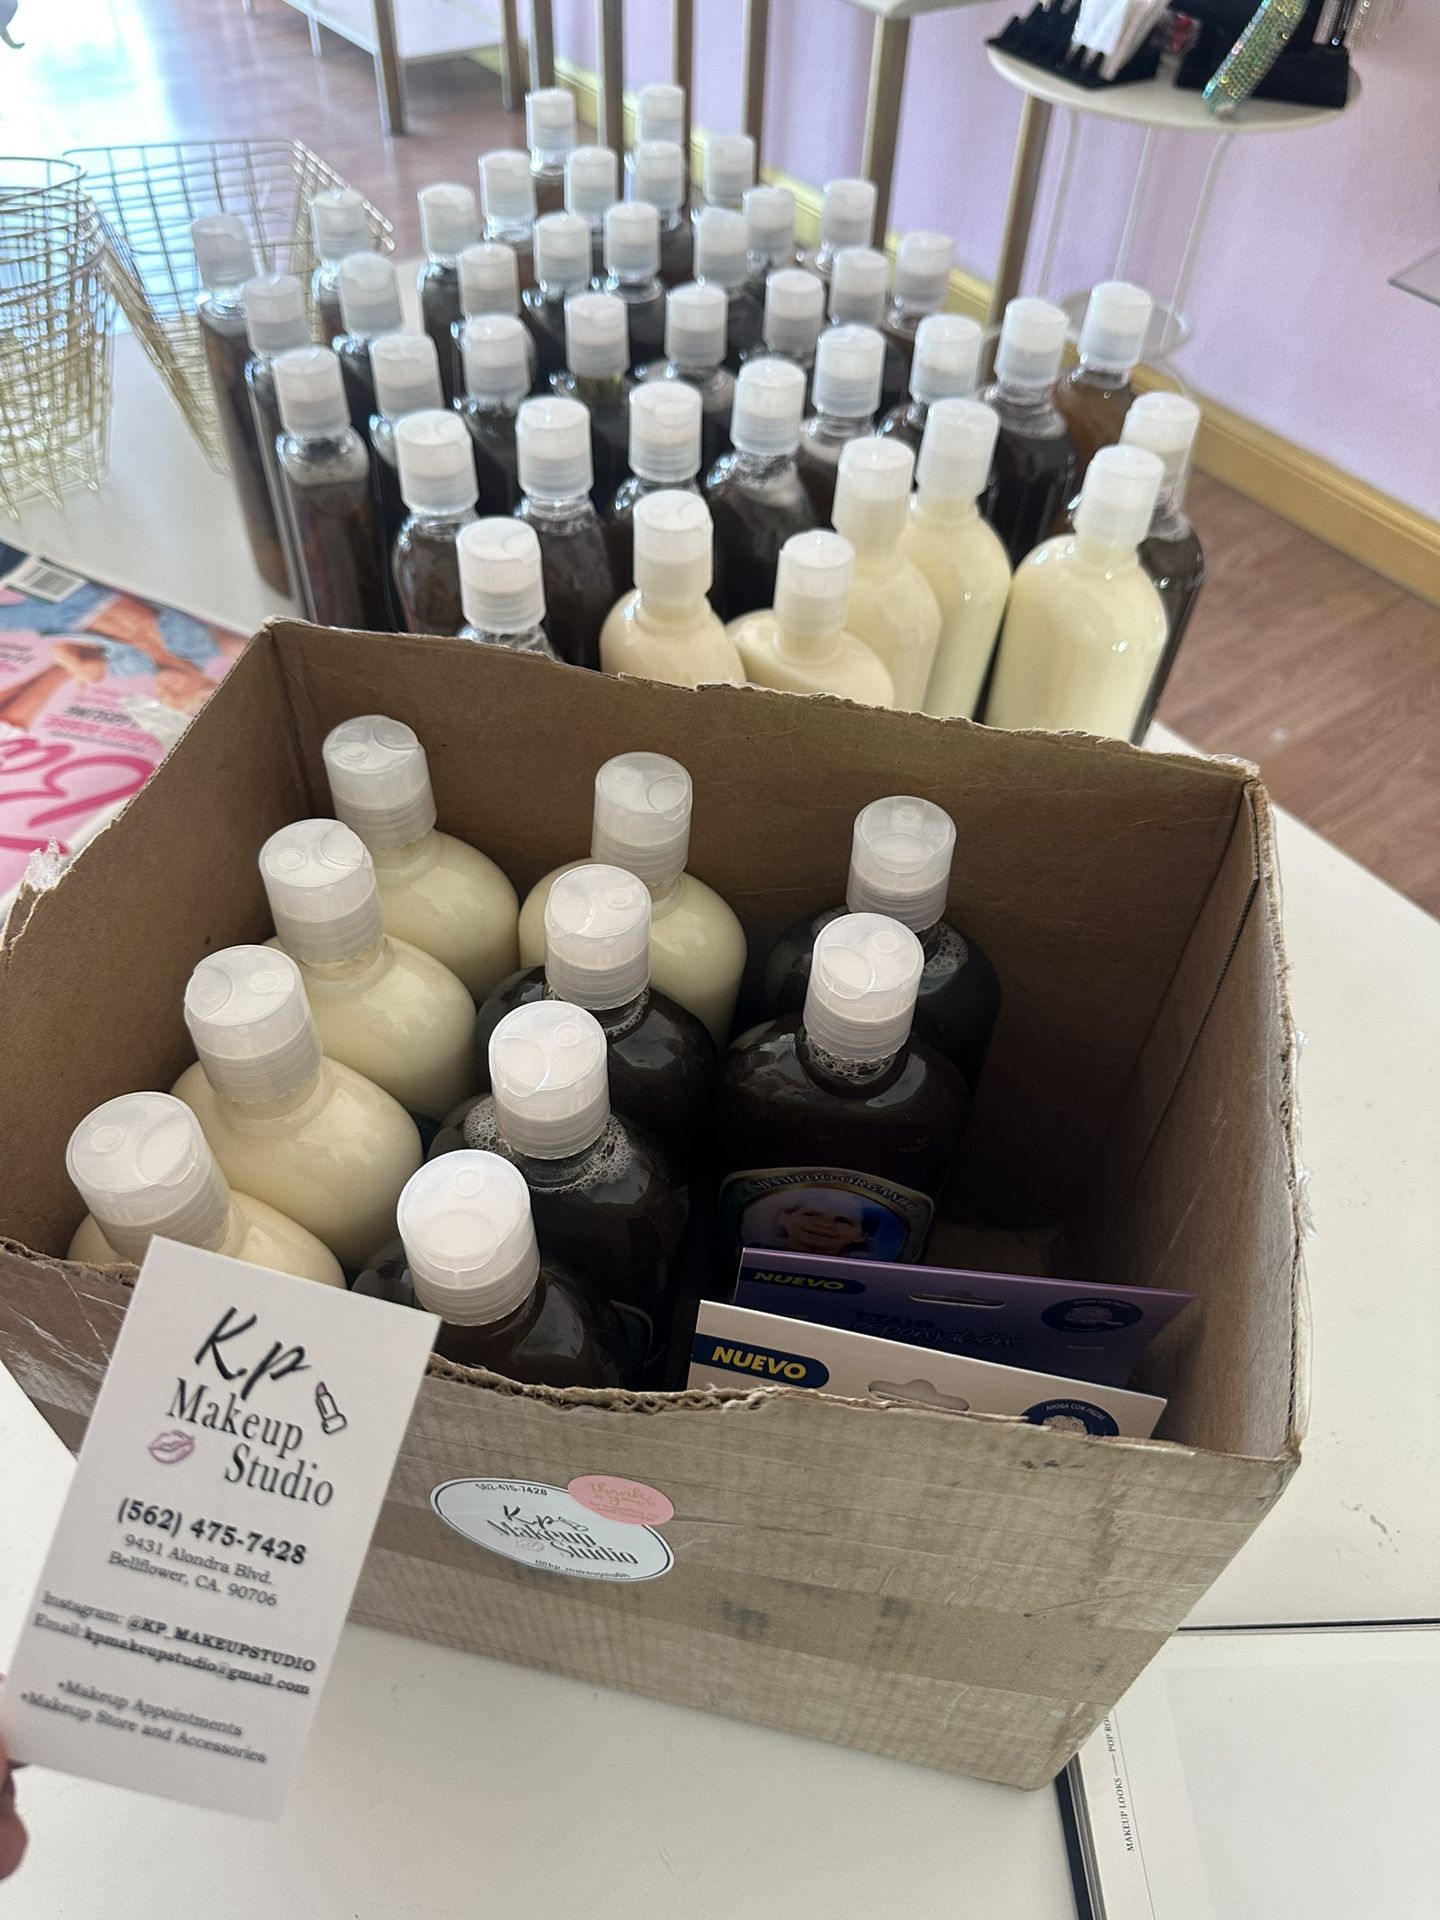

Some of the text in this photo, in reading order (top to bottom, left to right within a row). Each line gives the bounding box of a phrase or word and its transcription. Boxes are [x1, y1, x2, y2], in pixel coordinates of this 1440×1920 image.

[754, 1270, 844, 1290] NUEVO
[194, 1306, 312, 1401] Kp
[711, 1345, 807, 1381] NUEVO
[166, 1377, 304, 1458] Makeup
[224, 1443, 334, 1507] Studio
[117, 1497, 308, 1565] (562) 475-7428
[486, 1519, 597, 1550] Makeup
[502, 1504, 555, 1531] Kp
[125, 1533, 273, 1585] 9431 Alondra Blvd.
[548, 1540, 639, 1565] Studio
[108, 1551, 190, 1586] Bellflower,
[228, 1582, 278, 1607] 90706
[42, 1592, 317, 1673] Instagram: @KP_MAKEUPSTUDIO
[85, 1626, 310, 1695] kpmakeupstudio@gmail.com
[95, 1709, 139, 1733] Store
[141, 1726, 173, 1741] and
[176, 1730, 267, 1763] Accessories
[133, 1698, 243, 1737] Appointments
[1107, 1734, 1116, 1752] POP
[1115, 1777, 1127, 1809] LOOKS
[1120, 1811, 1135, 1852] MAKEUP
